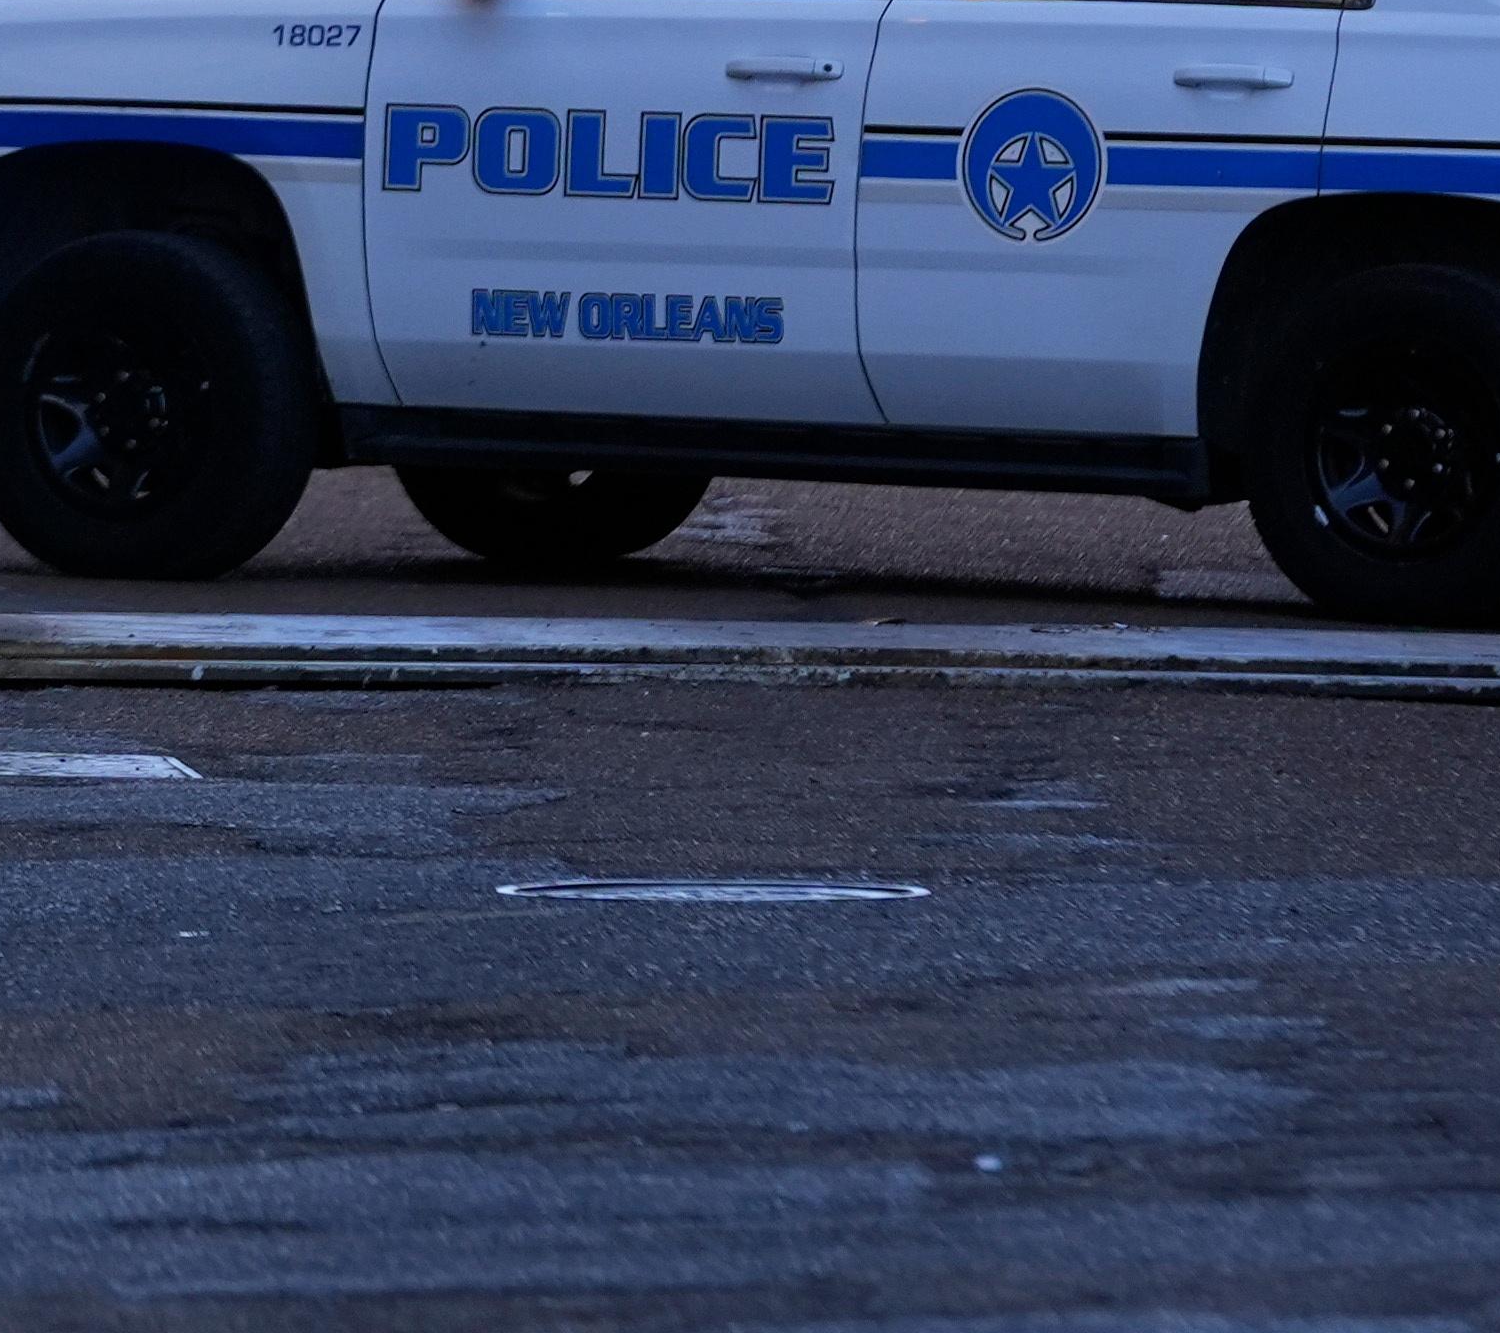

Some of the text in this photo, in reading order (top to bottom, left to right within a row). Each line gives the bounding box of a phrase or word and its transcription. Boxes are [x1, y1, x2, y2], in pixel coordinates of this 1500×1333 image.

[273, 24, 361, 47] 18027
[381, 103, 837, 205] POLICE
[472, 288, 785, 344] NEW ORLEANS
